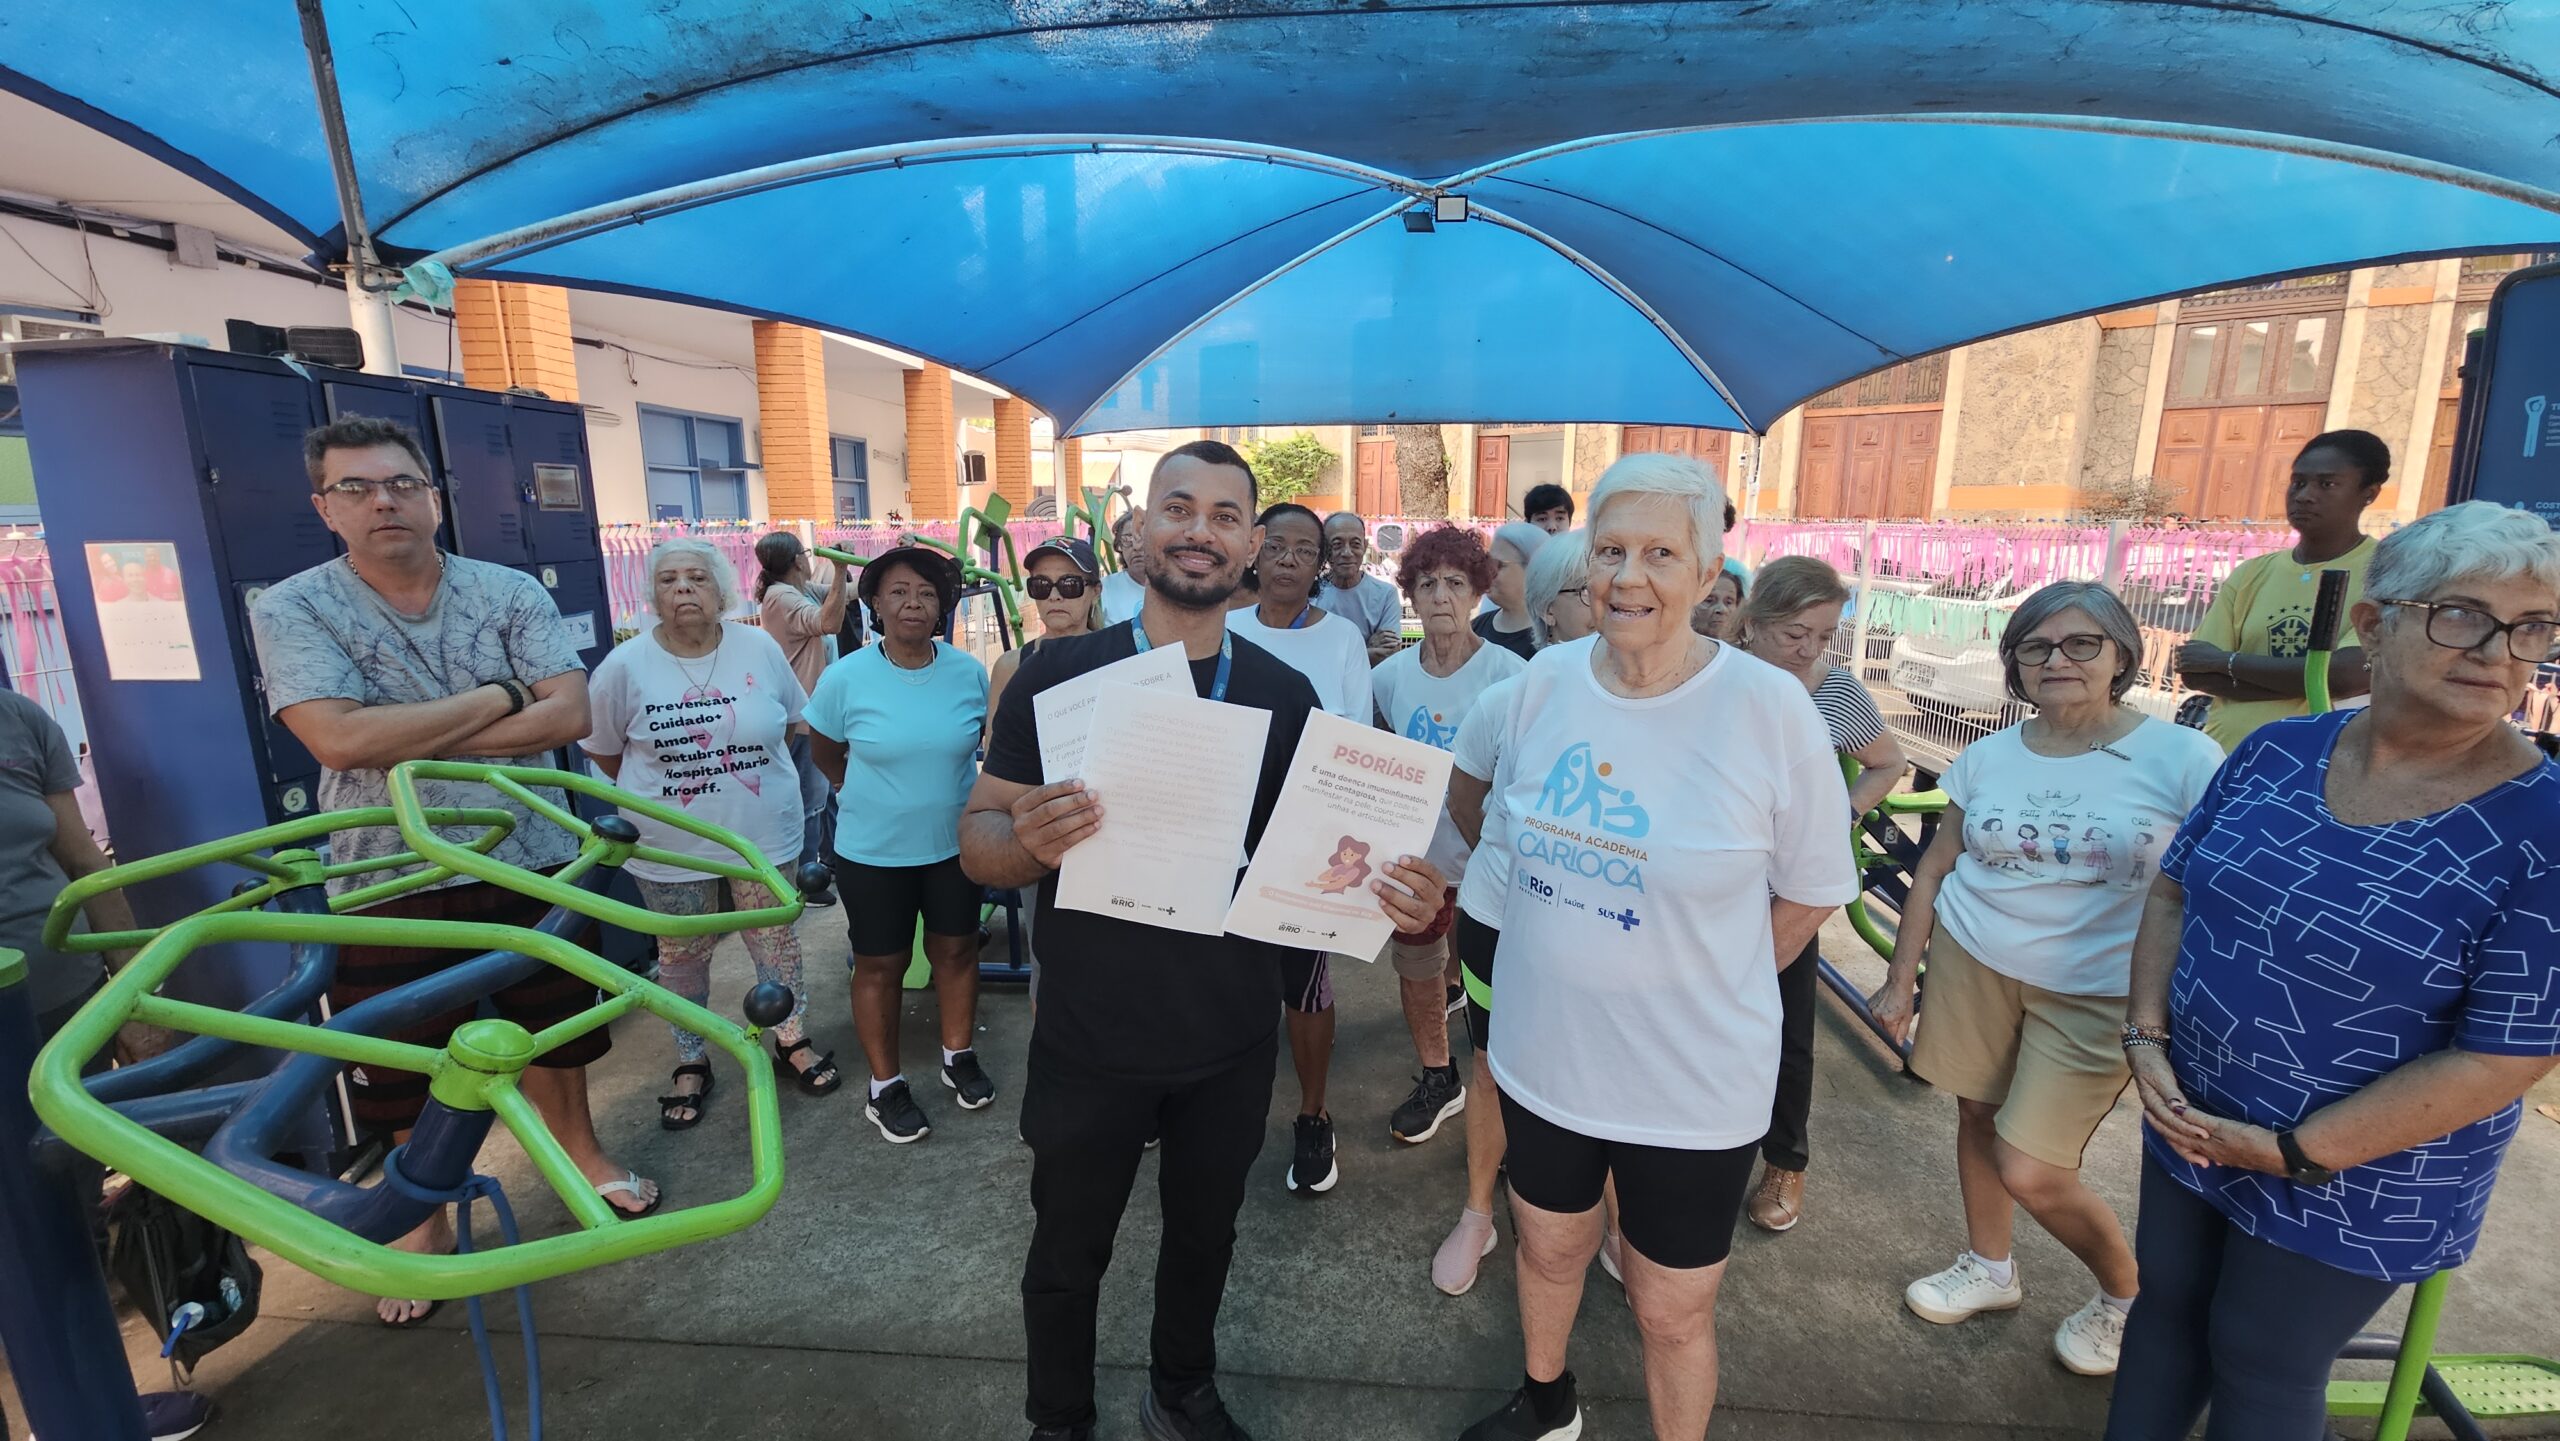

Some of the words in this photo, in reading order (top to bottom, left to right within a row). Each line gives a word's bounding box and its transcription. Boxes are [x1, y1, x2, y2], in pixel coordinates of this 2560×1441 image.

[1054, 708, 1067, 719] QUE
[1067, 699, 1086, 712] VOCÊ
[1140, 674, 1165, 688] SOBRE
[1166, 671, 1173, 679] A
[649, 713, 723, 732] Cuidado+
[654, 733, 706, 750] Amor=
[659, 748, 726, 764] Outubro
[728, 743, 764, 755] Rosa
[664, 763, 728, 780] Hospital
[729, 755, 770, 773] Mario
[1333, 744, 1427, 785] PSORÍASE
[662, 782, 722, 797] Kroeff.
[1319, 769, 1337, 780] uma
[1338, 774, 1366, 790] doença
[291, 792, 299, 807] 5
[1318, 778, 1334, 792] não
[1335, 782, 1379, 803] contagiosa,
[1327, 802, 1350, 815] unhas
[1524, 815, 1581, 843] PROGRAMA
[1584, 835, 1649, 862] ACADEMIA
[1517, 831, 1646, 895] CARIOCA
[1529, 875, 1554, 897] Rio
[1119, 899, 1135, 908] RIO
[1564, 898, 1586, 911] SAÚDE
[1597, 907, 1616, 920] SUS
[1286, 924, 1301, 935] RIO
